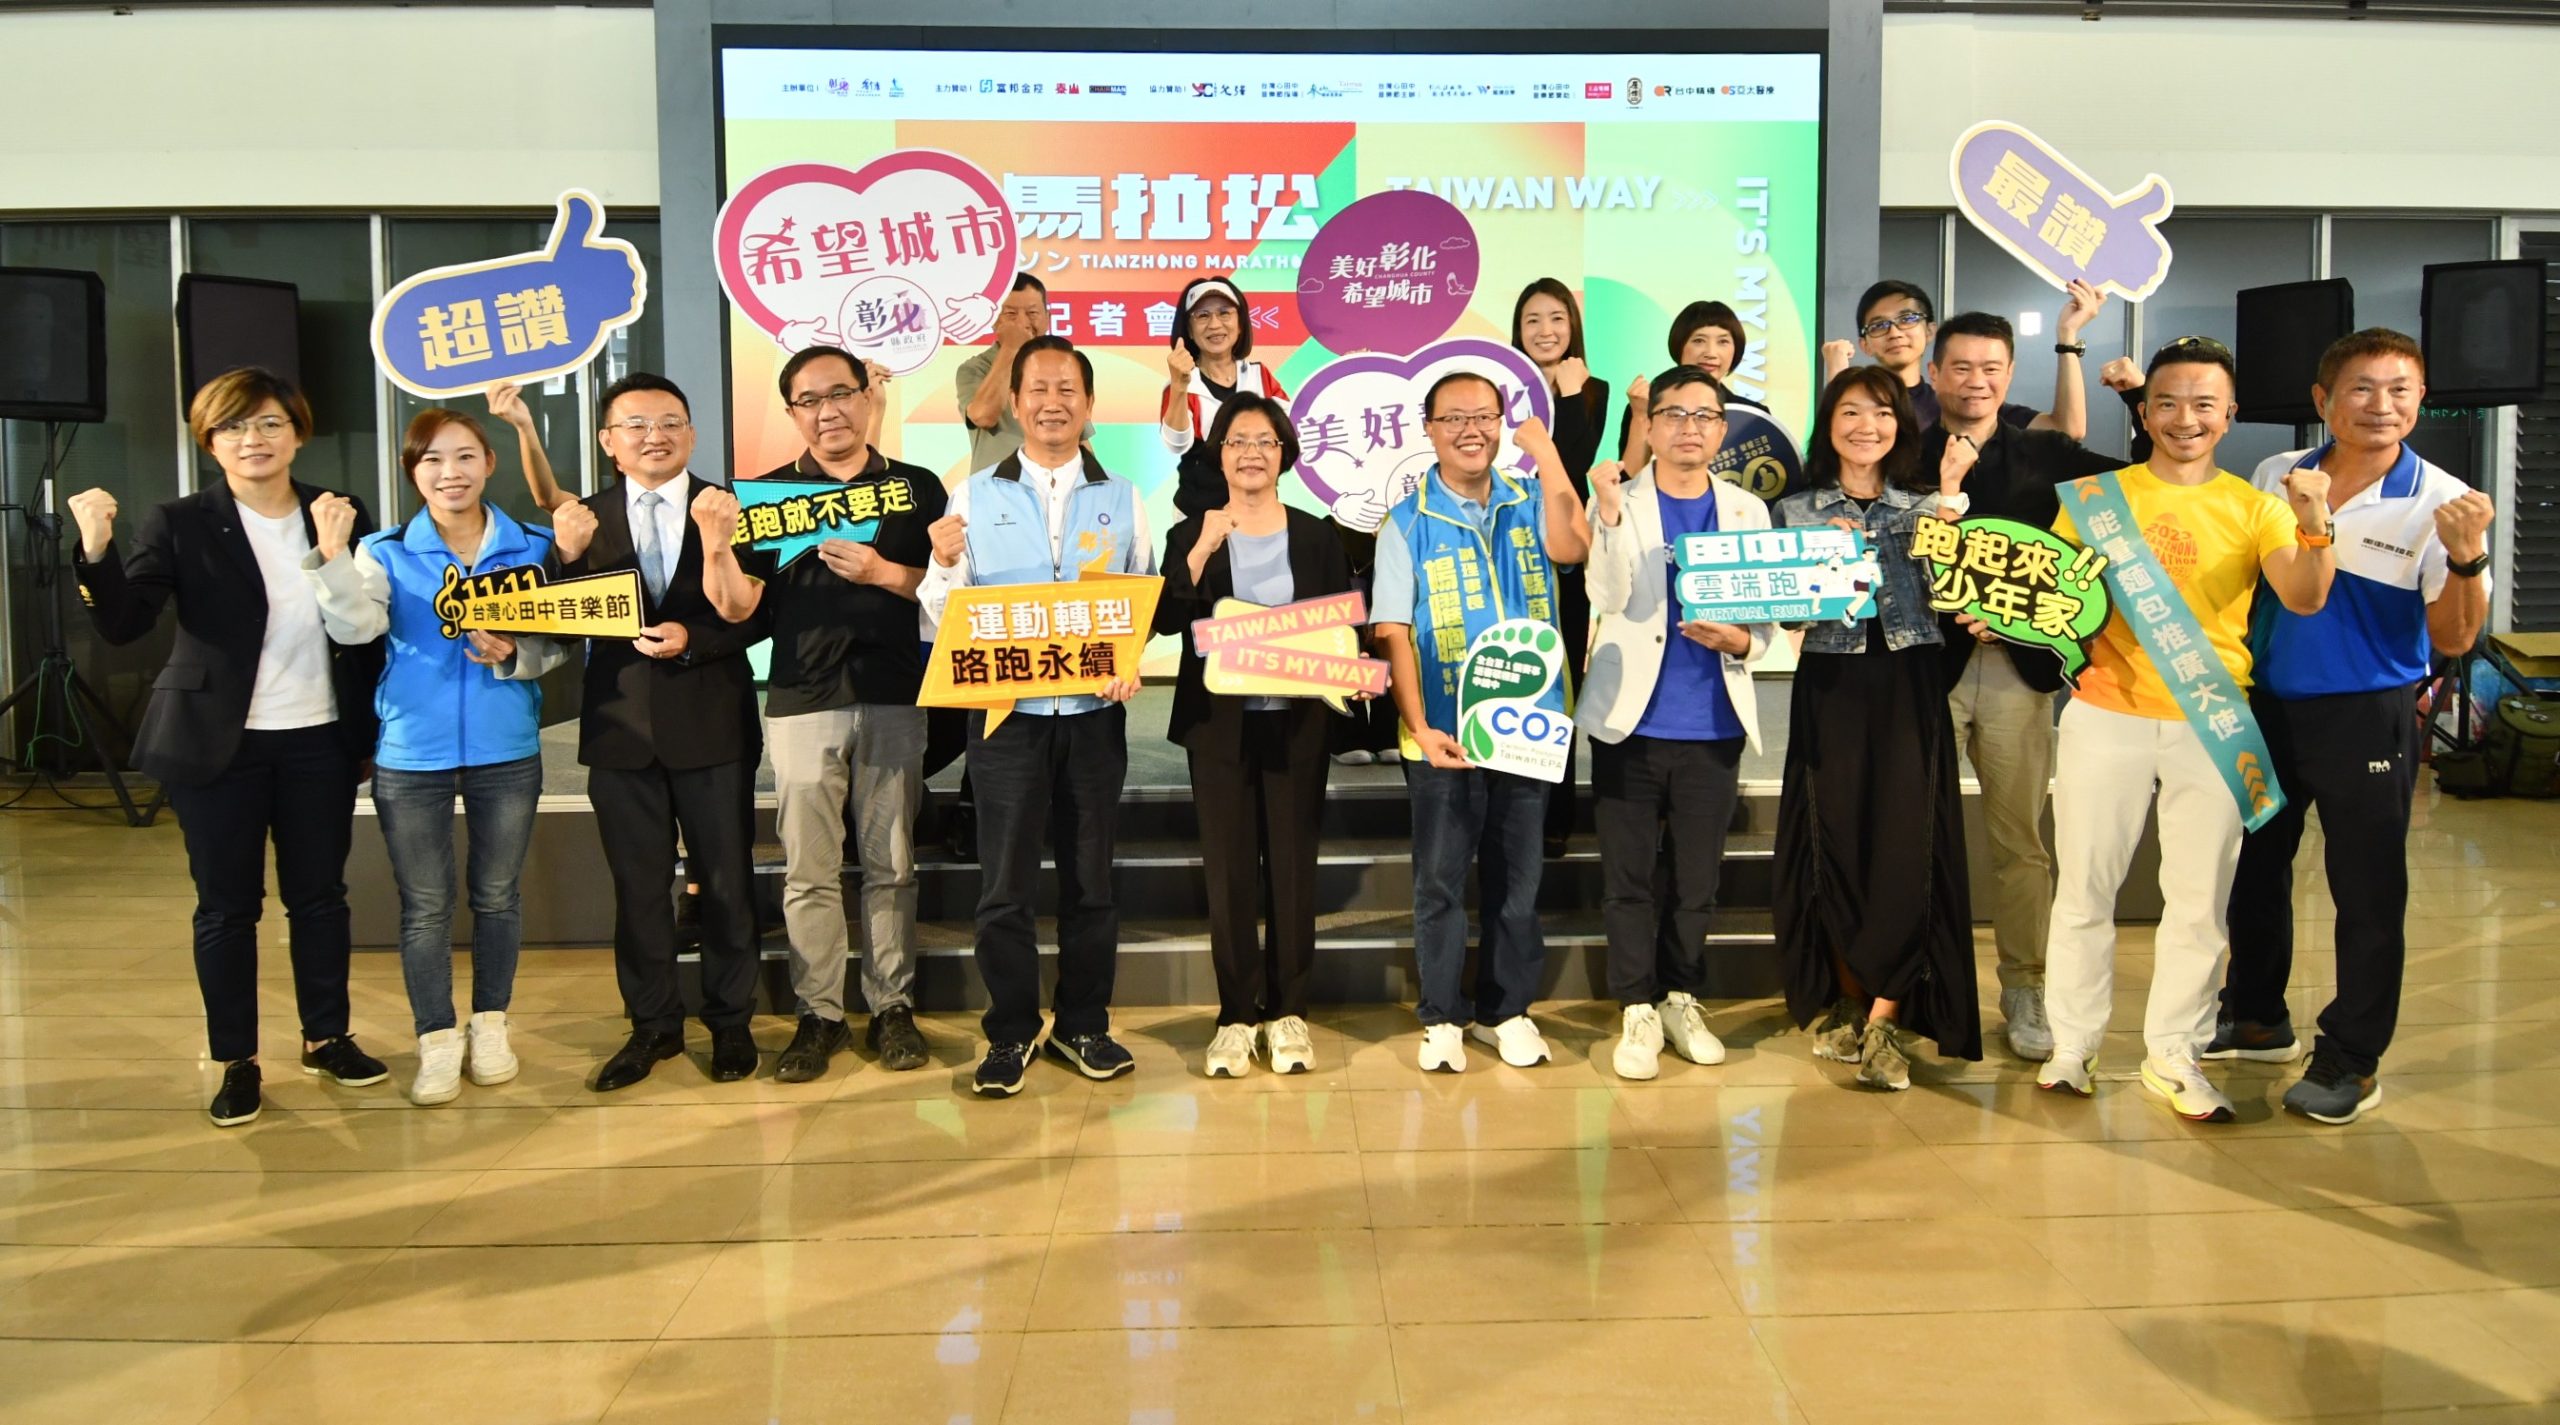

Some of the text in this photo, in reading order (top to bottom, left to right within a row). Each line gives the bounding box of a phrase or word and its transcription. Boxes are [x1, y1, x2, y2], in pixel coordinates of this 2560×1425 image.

[997, 83, 1043, 94] 富邦金控
[1056, 83, 1079, 94] 泰山
[1002, 173, 1321, 240] 馬拉松
[1564, 176, 1662, 209] WAY
[1982, 149, 2107, 272] 最讚
[1736, 176, 1769, 255] IT'S
[743, 204, 1002, 286] 希望城市
[1079, 253, 1302, 270] TIANZHONG MARATHO
[1329, 241, 1438, 280] 美好彰化
[855, 290, 925, 335] 彰化
[1341, 279, 1434, 308] 希望城市
[1734, 267, 1768, 331] MY
[417, 283, 572, 371] 超讚
[1734, 339, 1768, 403] WA
[1744, 444, 1772, 460] 2023
[2145, 523, 2193, 541] 2023
[1694, 571, 1800, 600] 雲端跑
[1931, 568, 2082, 640] 少年家
[473, 594, 631, 622] 台灣心田中音樂節
[966, 597, 1136, 641] 運動轉型
[1207, 600, 1353, 645] TAIWAN WAY
[1695, 603, 1810, 622] VIRTUAL RUN
[2087, 509, 2245, 742] 能量麵包推廣大使
[951, 641, 1117, 686] 路跑永續
[1236, 647, 1378, 686] IT'S MY WAY
[1501, 749, 1562, 769] Taiwan EPA
